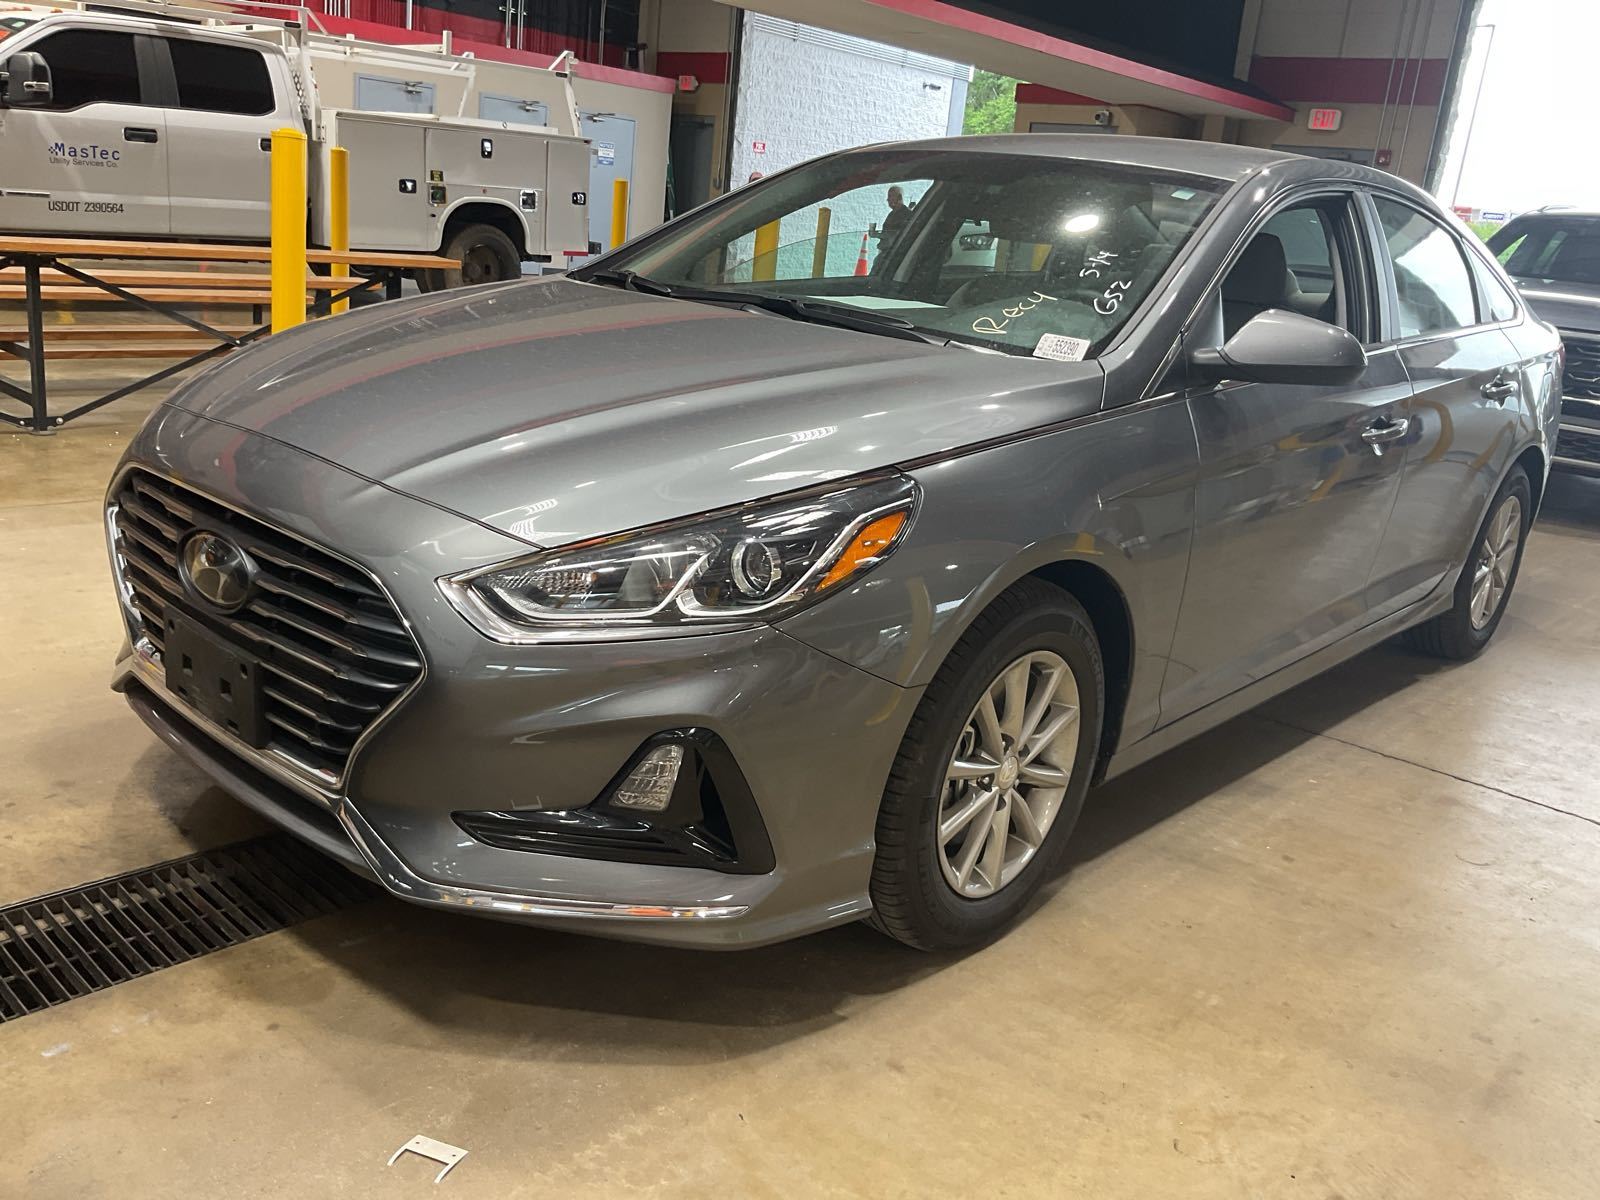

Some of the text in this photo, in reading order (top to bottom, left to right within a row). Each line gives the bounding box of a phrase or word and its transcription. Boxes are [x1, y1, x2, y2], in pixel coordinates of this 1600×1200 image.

[1312, 111, 1336, 128] EXIT
[54, 142, 120, 161] MasTec
[49, 157, 119, 168] Utility Services Co.
[48, 201, 124, 213] USDOT 2390564
